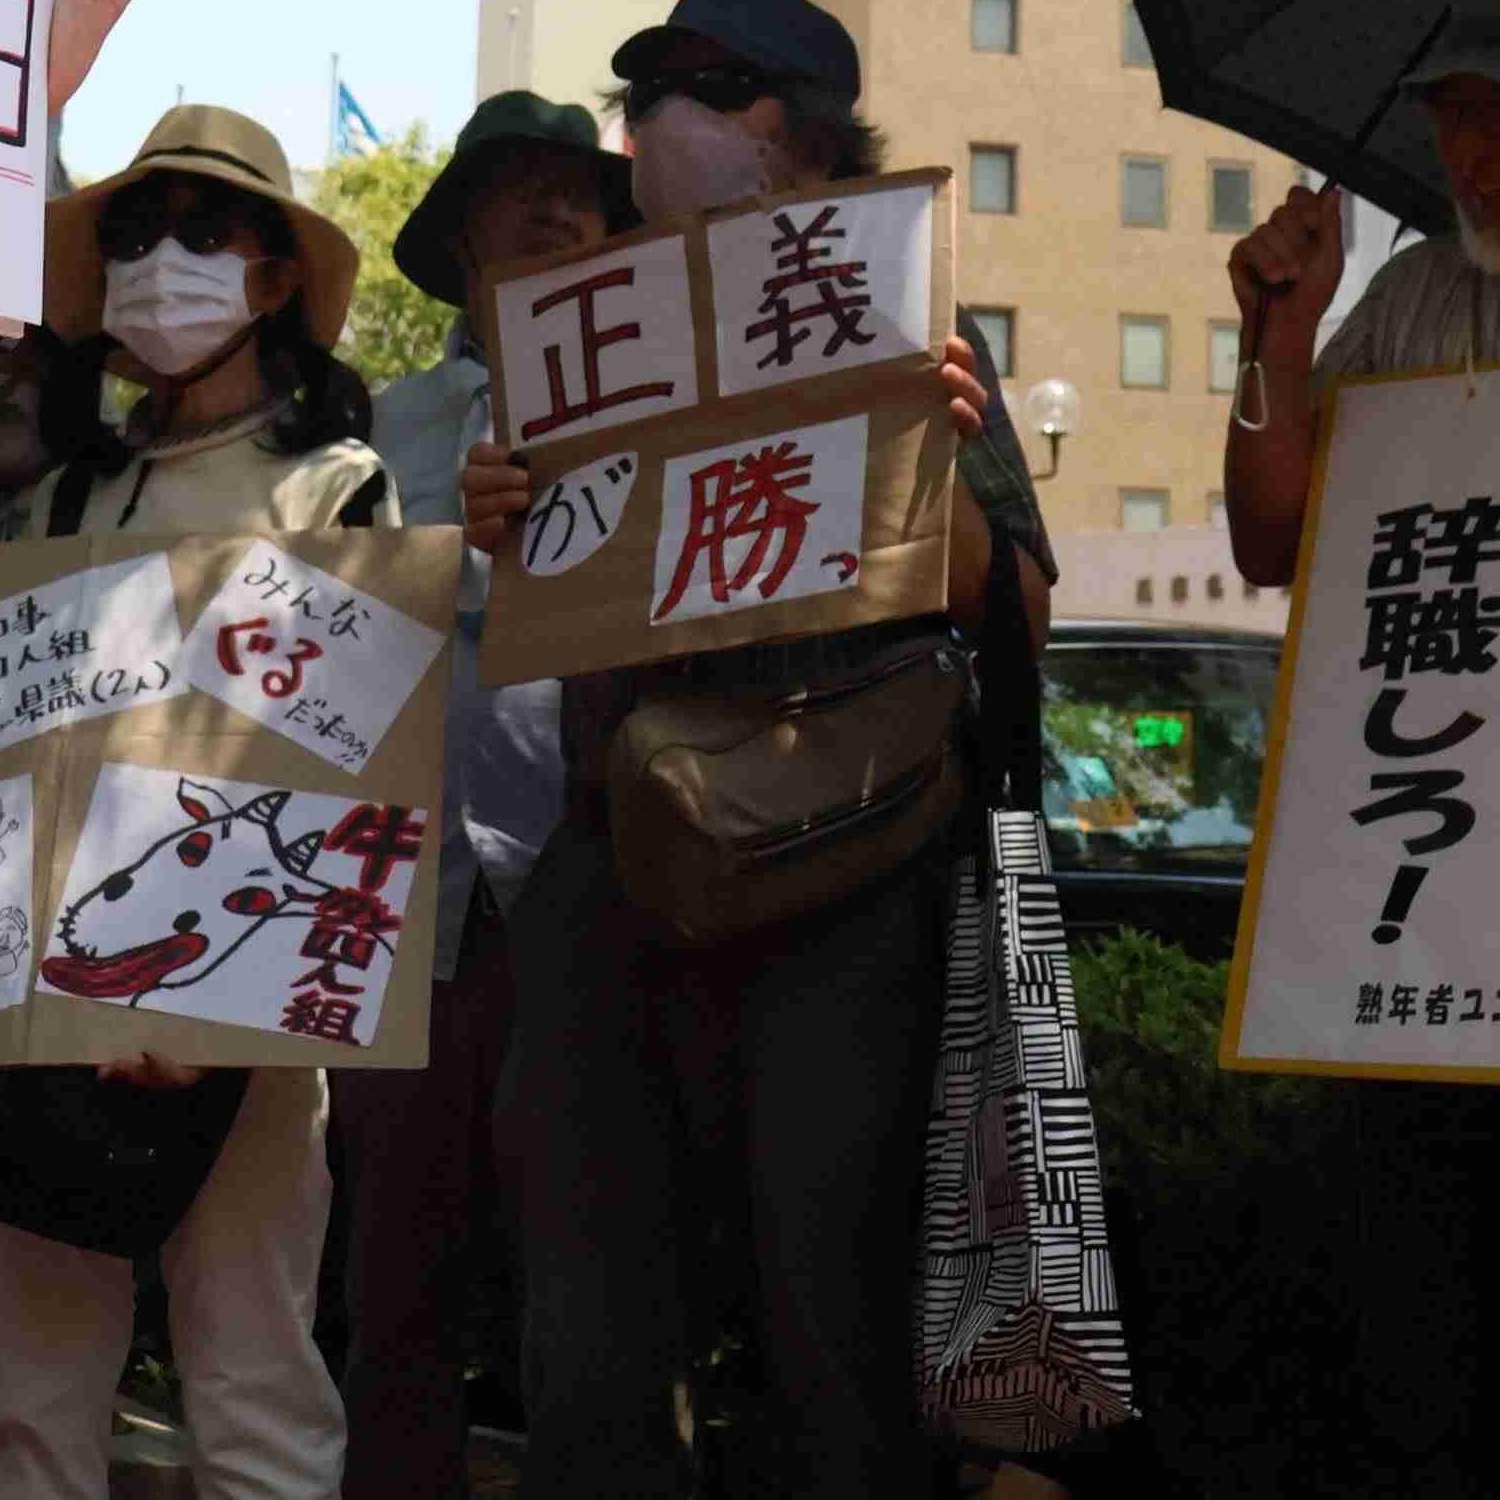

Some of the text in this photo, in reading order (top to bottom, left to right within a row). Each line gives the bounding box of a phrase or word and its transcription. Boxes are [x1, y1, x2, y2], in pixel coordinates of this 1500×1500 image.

[521, 204, 878, 441] 正義
[243, 558, 373, 643] みんな
[216, 616, 325, 699] ぐる
